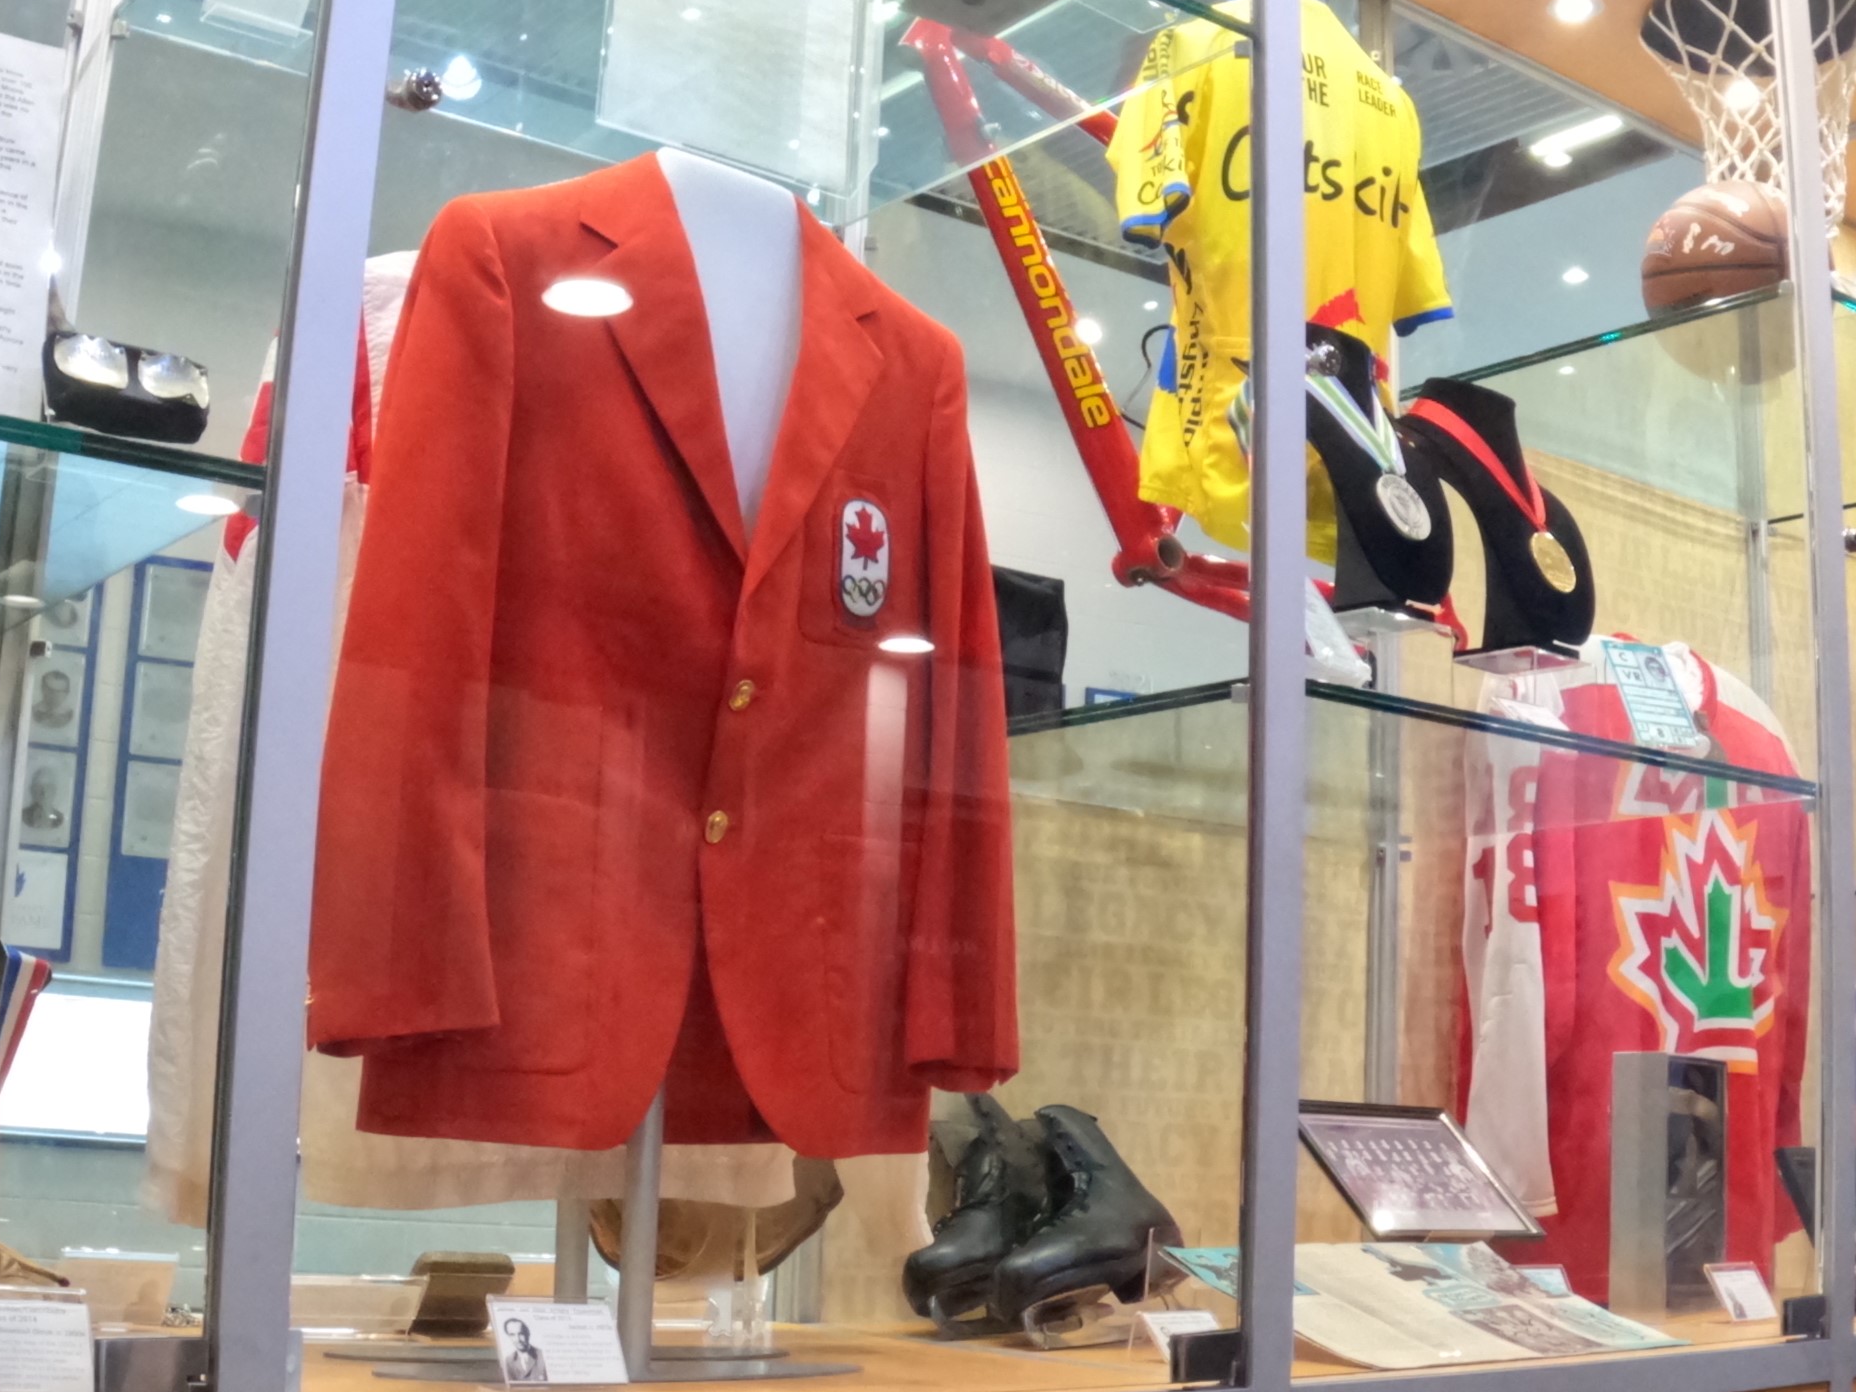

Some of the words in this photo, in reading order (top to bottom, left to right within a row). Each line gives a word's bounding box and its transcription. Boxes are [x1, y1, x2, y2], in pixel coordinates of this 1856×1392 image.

[1302, 76, 1330, 108] HE
[1356, 70, 1384, 95] RACE
[1357, 89, 1398, 118] LEADER
[983, 155, 1112, 429] cannondale
[1469, 831, 1538, 937] 18
